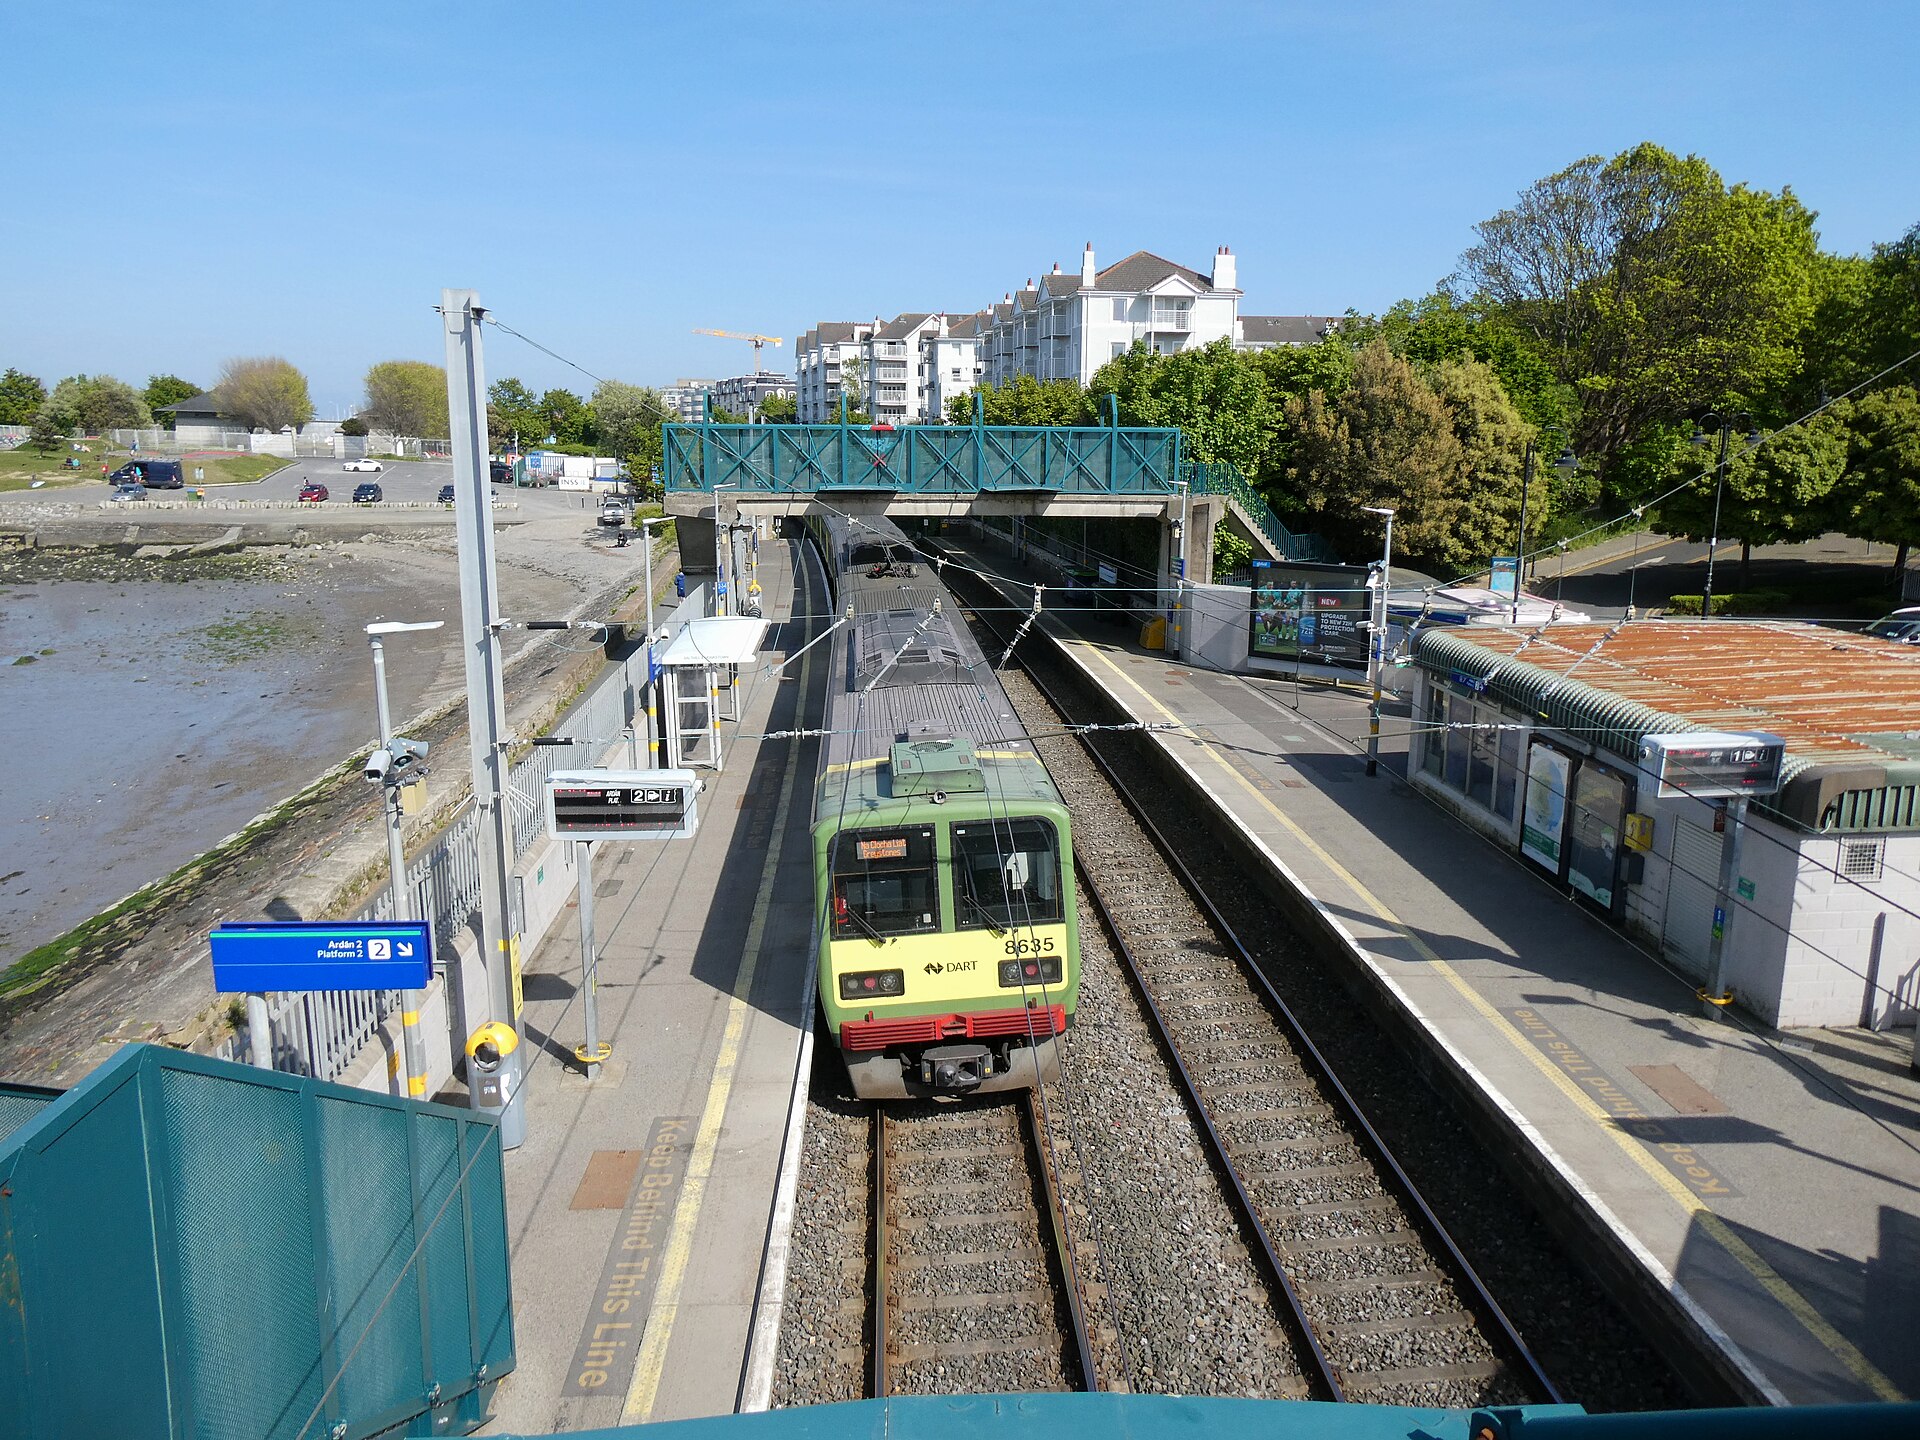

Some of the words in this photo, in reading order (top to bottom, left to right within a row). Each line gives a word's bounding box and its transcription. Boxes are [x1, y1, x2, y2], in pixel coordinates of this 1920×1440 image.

[1321, 598, 1336, 606] NEW
[1320, 612, 1348, 621] UPGRADE
[1320, 624, 1355, 633] PROTECTION
[633, 790, 643, 802] 2
[863, 849, 902, 859] Greystones
[328, 940, 354, 949] Ardán
[356, 940, 363, 949] 2
[374, 942, 386, 957] 2
[1005, 937, 1054, 955] 8635
[317, 949, 355, 958] Platform
[357, 949, 364, 958] 2
[946, 961, 978, 973] DART
[1513, 1008, 1558, 1040] Line
[1547, 1040, 1594, 1074] This
[1580, 1075, 1666, 1137] Behind
[646, 1119, 690, 1169] Keep
[1659, 1142, 1730, 1195] Keep
[621, 1173, 674, 1250] Behind
[602, 1256, 651, 1314] This
[577, 1321, 633, 1389] Line
